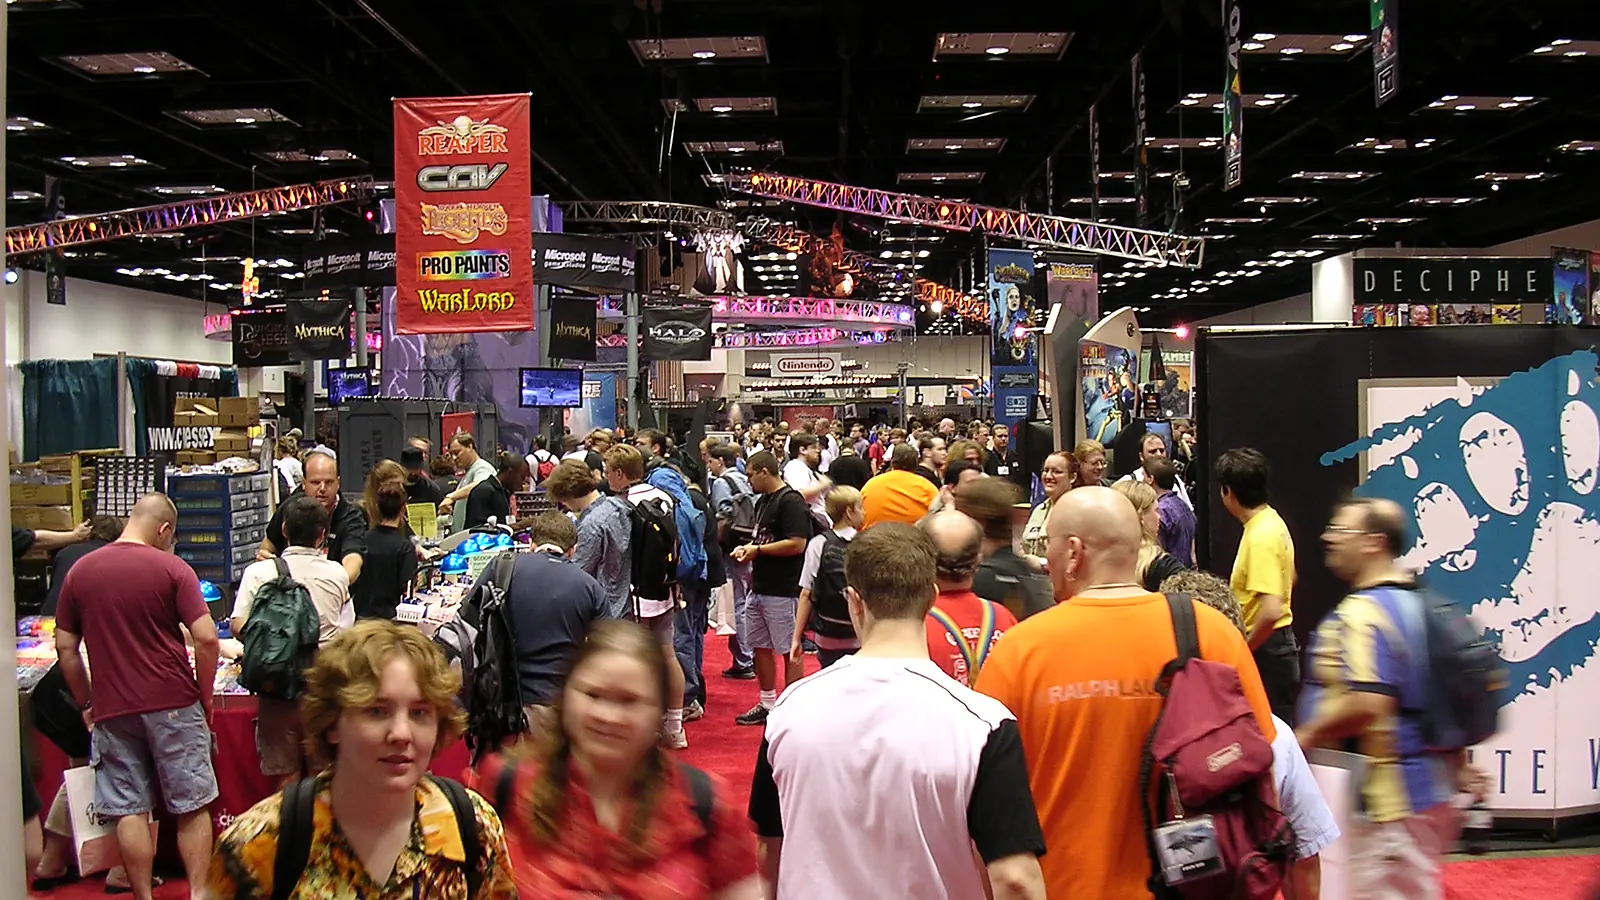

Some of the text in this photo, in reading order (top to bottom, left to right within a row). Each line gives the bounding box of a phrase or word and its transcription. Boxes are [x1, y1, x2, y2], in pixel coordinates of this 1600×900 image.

[418, 133, 508, 155] REAPER
[417, 163, 509, 192] CAV
[420, 256, 452, 275] PRO
[455, 254, 509, 274] PAINTS
[544, 249, 586, 261] Microsoft
[295, 323, 345, 341] MYTHICA
[555, 316, 591, 342] MYTHICA
[649, 327, 706, 338] HALO
[781, 360, 830, 370] Nintendo
[1048, 680, 1119, 703] RALPH
